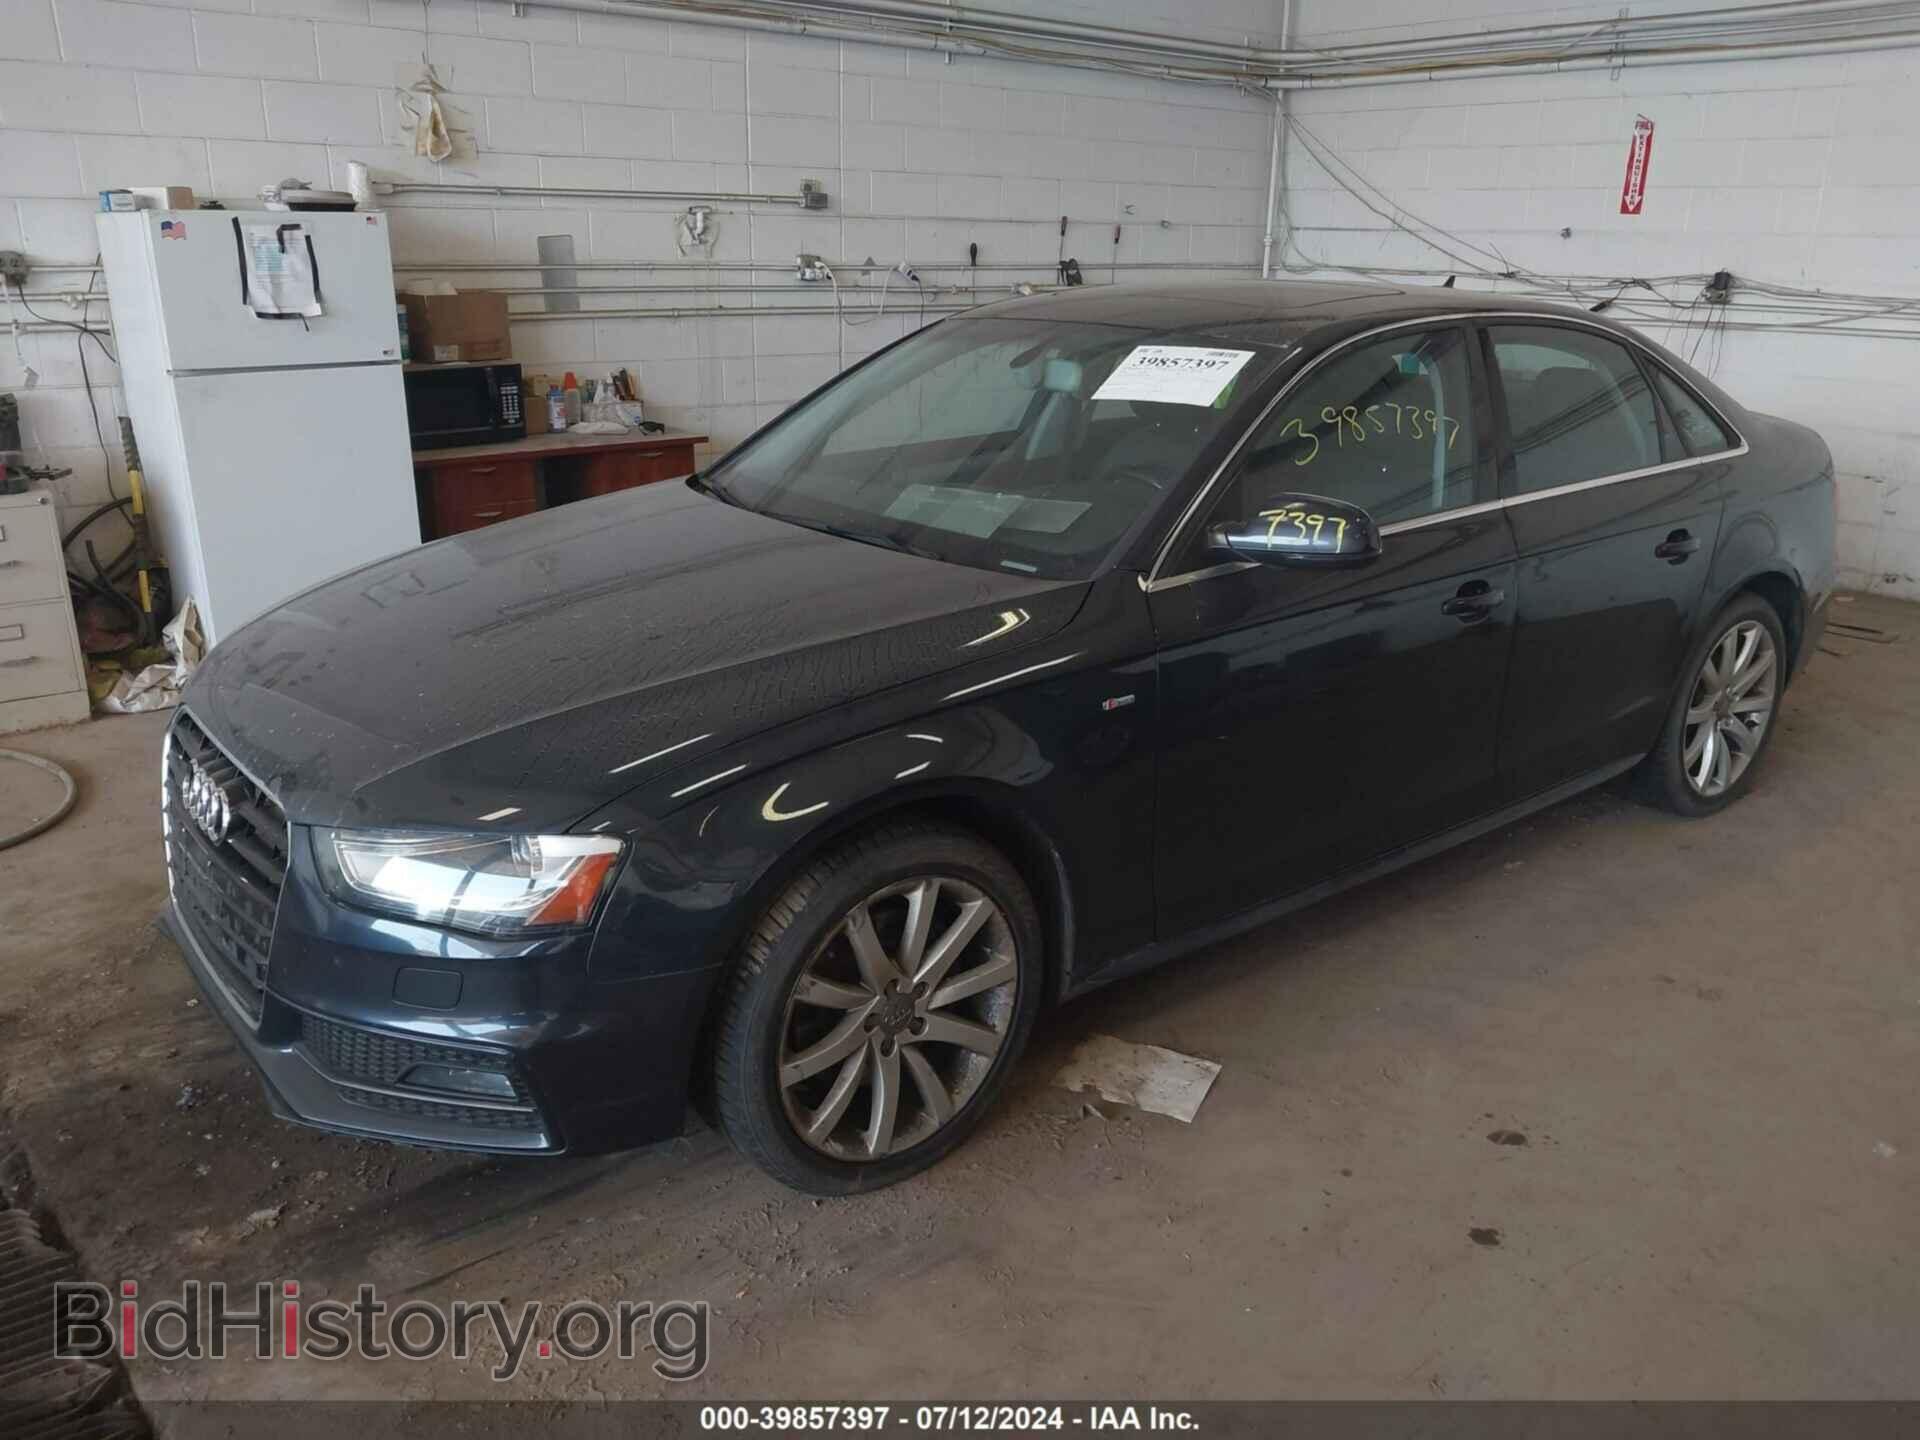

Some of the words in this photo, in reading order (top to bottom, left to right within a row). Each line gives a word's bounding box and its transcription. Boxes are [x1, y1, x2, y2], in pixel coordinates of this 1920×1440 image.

[1133, 356, 1230, 370] 39857397
[1279, 402, 1460, 466] 39857397
[1259, 509, 1346, 554] 7397
